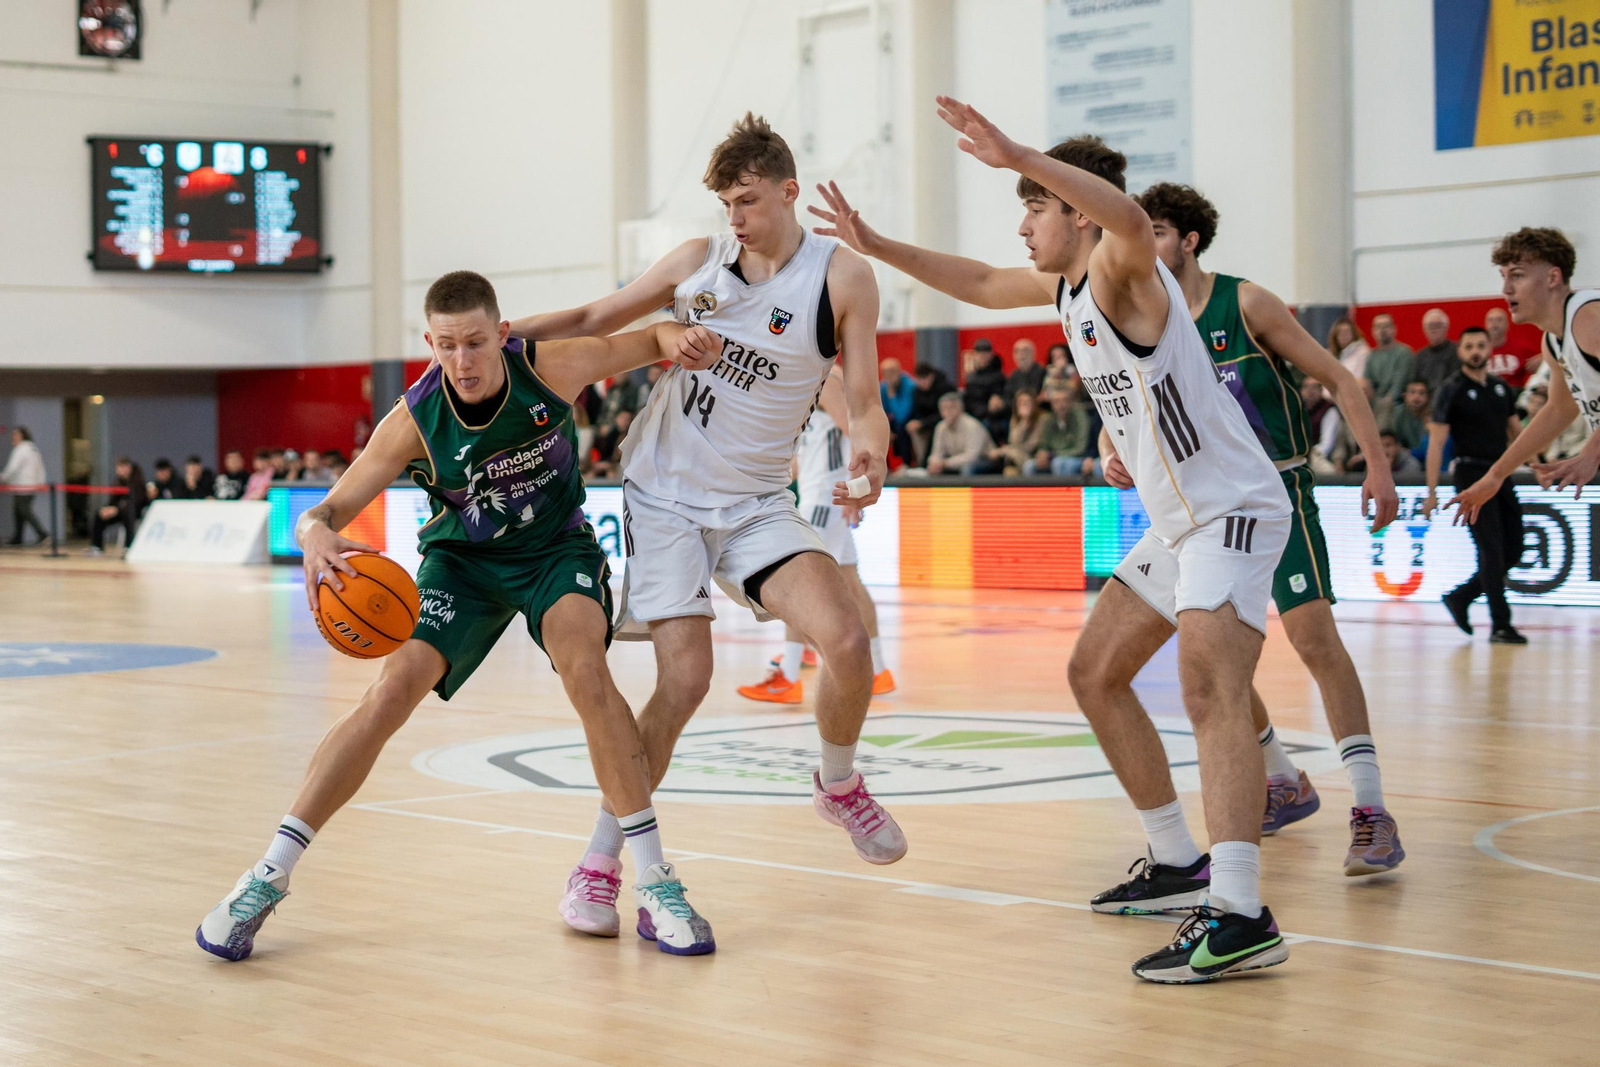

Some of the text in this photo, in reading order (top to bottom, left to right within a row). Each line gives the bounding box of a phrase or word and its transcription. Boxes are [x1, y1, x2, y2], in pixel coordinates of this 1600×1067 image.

[1502, 54, 1600, 95] Infan
[773, 309, 790, 321] LIGA
[718, 334, 780, 381] rates
[529, 402, 546, 414] LIGA
[683, 374, 716, 429] 14
[486, 434, 558, 471] Fundación
[488, 456, 544, 480] Unicaja
[511, 469, 558, 499] de la Torre
[417, 617, 441, 631] NTAL
